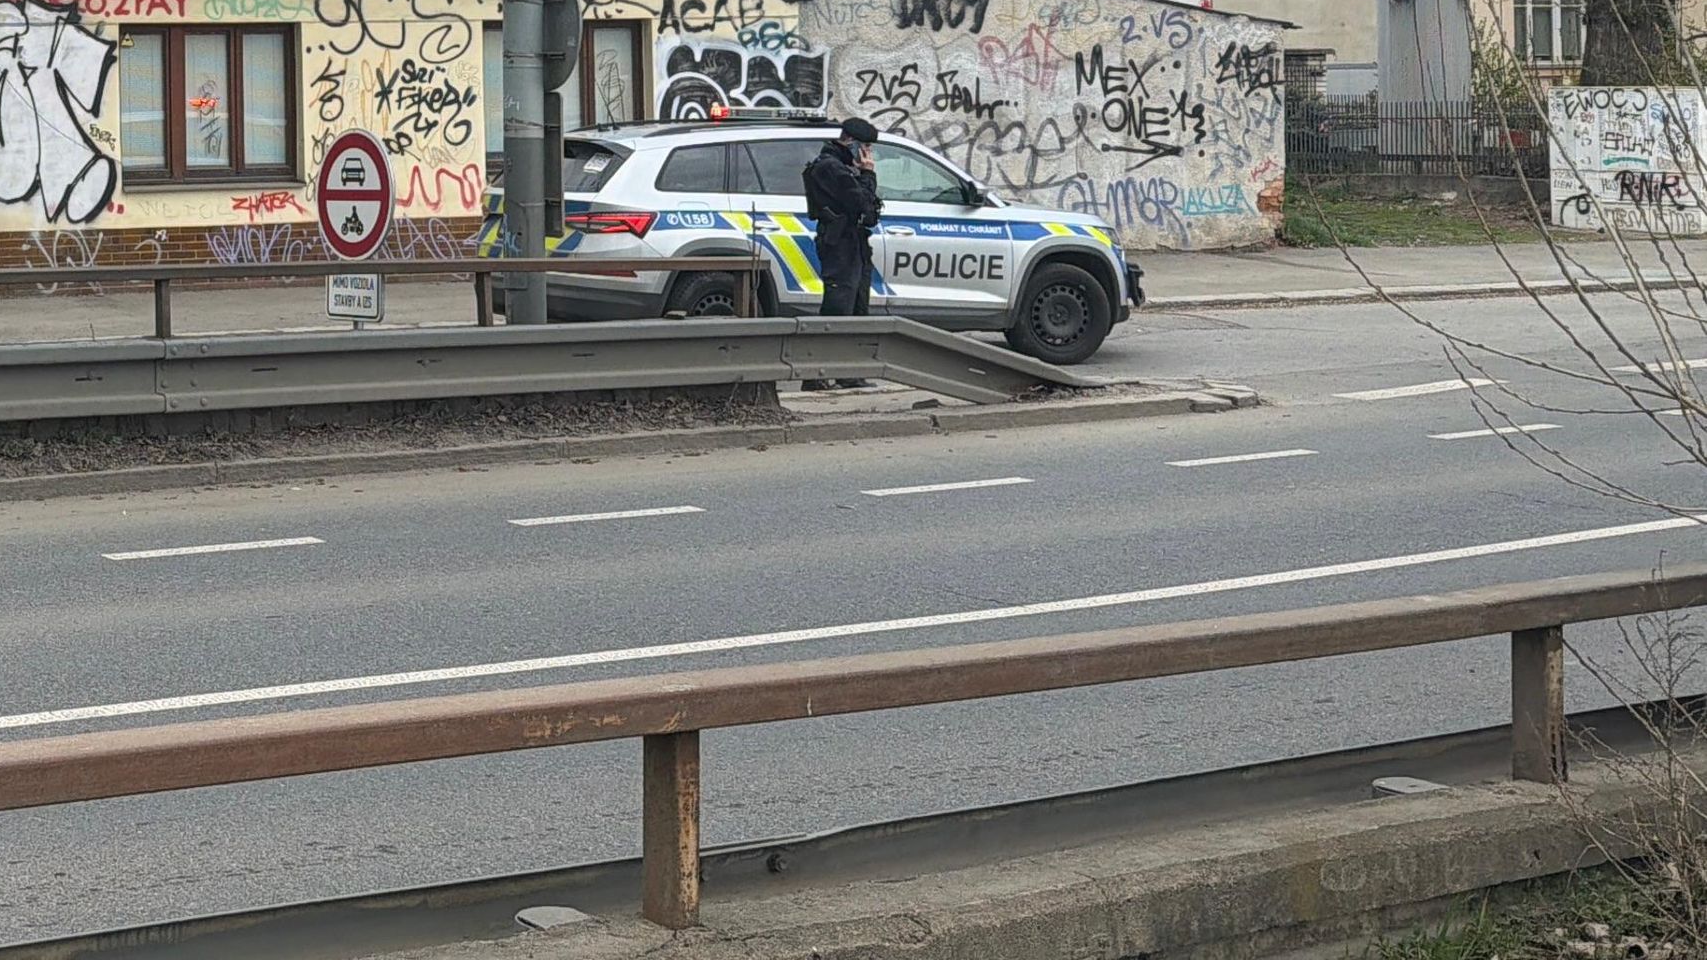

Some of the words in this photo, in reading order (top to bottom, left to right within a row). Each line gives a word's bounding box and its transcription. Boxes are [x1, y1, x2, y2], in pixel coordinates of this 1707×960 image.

[1075, 43, 1162, 98] MEX
[685, 214, 708, 224] 158
[919, 222, 958, 233] POMÁHAT
[960, 224, 967, 233] A
[967, 223, 1003, 234] CHRÁNIT
[892, 251, 1004, 280] POLICIE
